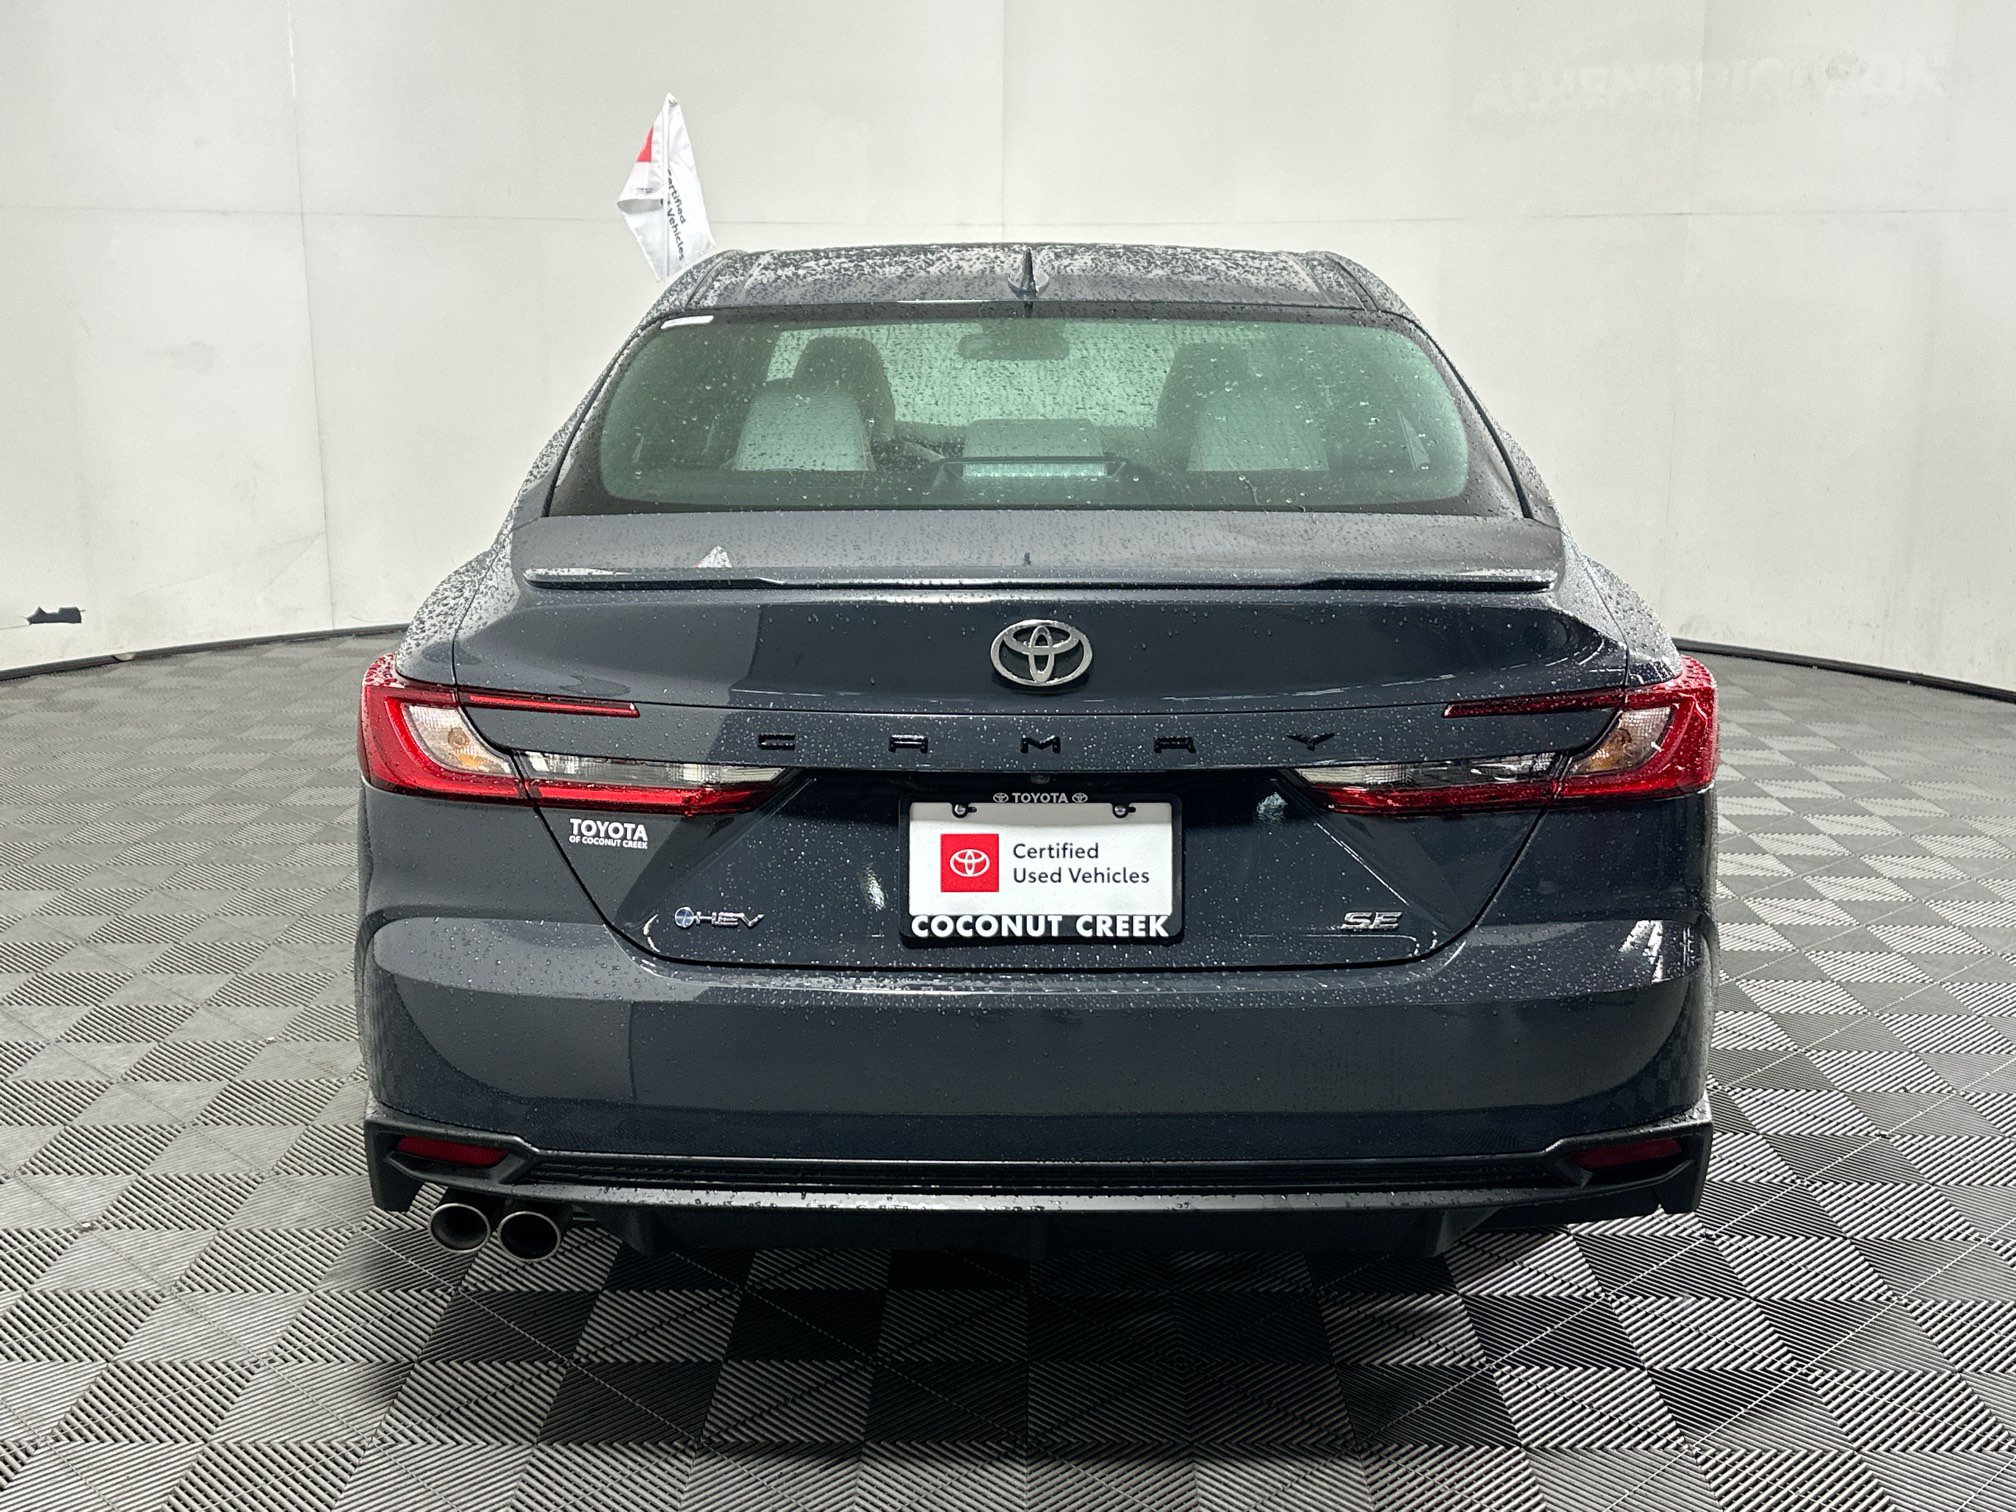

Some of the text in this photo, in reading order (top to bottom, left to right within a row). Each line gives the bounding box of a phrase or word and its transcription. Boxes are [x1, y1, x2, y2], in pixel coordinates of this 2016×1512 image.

[667, 207, 685, 261] Vehicles
[758, 732, 1336, 754] CAMRY
[1012, 792, 1069, 804] TOYOTA
[569, 818, 648, 841] TOYOTA
[568, 835, 648, 849] OF COCONUT CREEK
[1013, 842, 1099, 859] Certified
[1013, 867, 1150, 884] Used Vehicles
[910, 914, 1170, 938] COCONUT CREEK
[1340, 911, 1403, 931] SE
